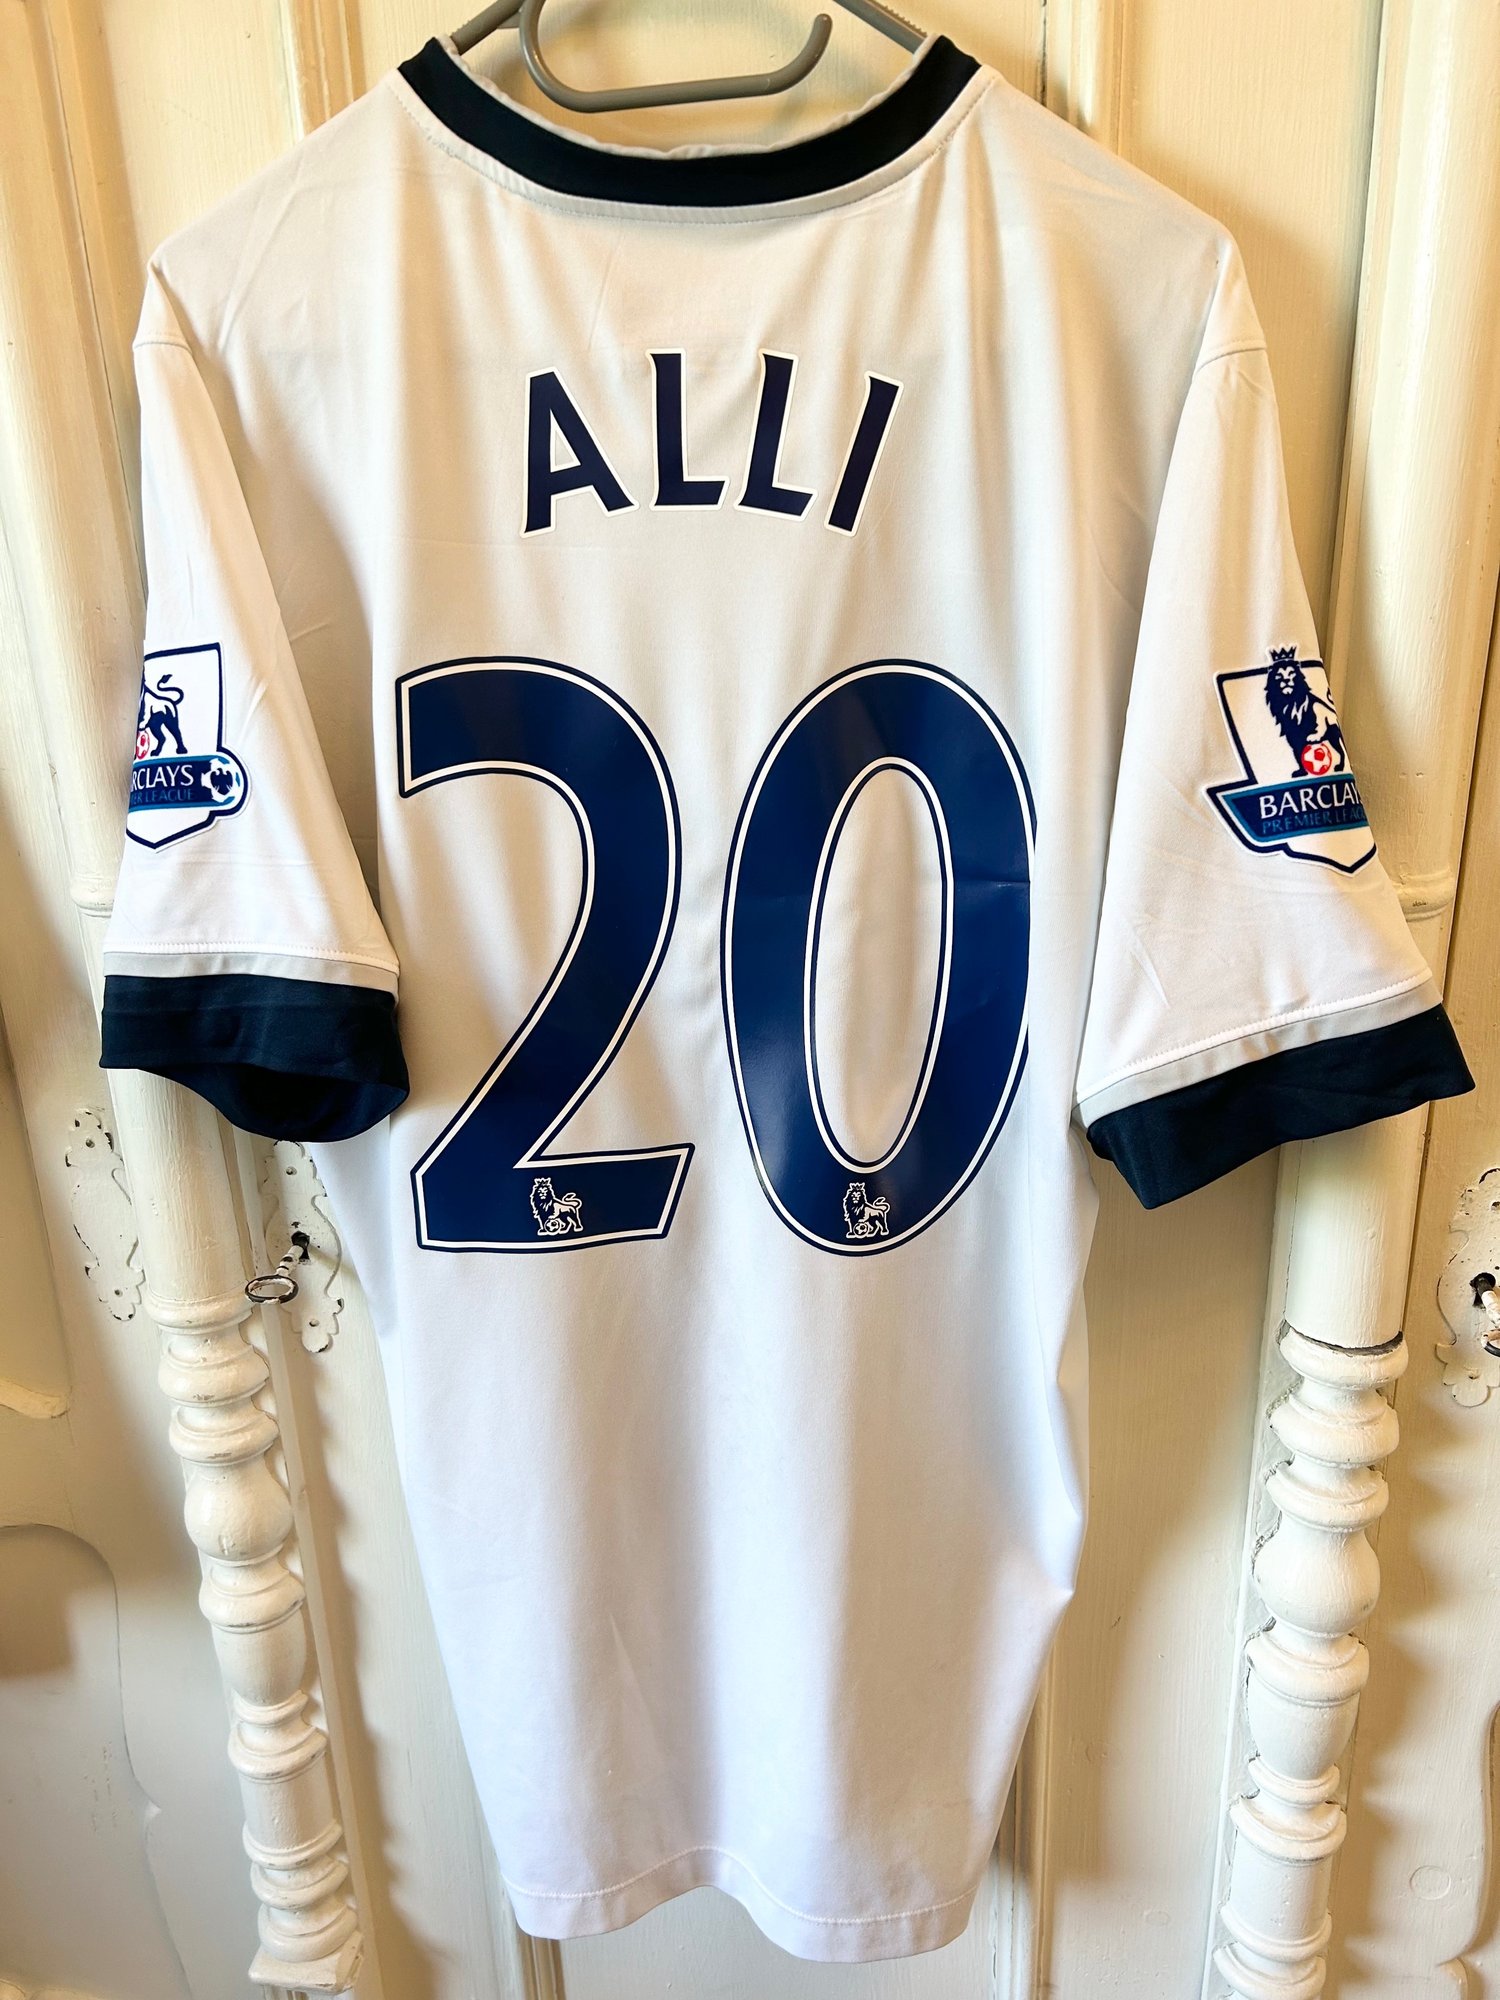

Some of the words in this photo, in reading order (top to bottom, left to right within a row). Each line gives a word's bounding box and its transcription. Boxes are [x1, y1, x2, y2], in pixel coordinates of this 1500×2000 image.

[523, 350, 901, 535] ALLI
[131, 764, 195, 792] RCLAYS
[1258, 781, 1363, 820] BARCLAY
[1262, 811, 1332, 835] PREMIER
[396, 656, 1037, 1257] 20
